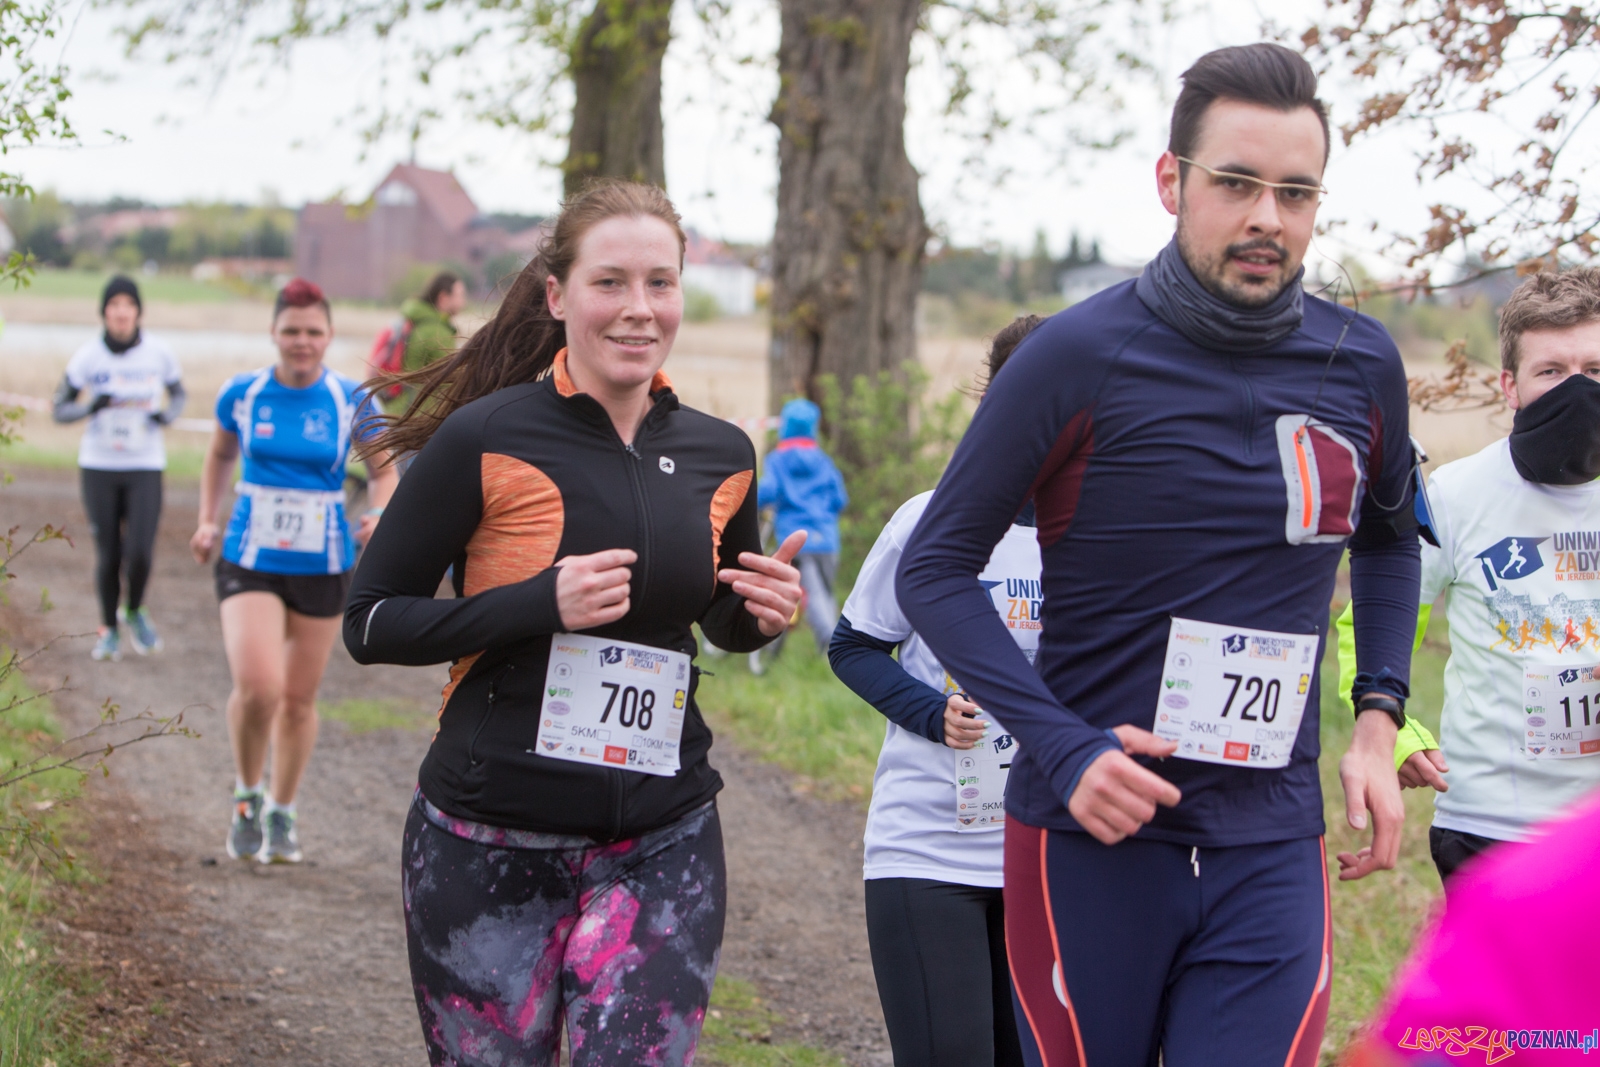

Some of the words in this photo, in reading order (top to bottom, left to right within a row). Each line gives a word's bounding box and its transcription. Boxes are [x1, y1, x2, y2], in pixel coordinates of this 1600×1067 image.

[1553, 531, 1600, 551] UNIW
[1567, 572, 1595, 581] JERZEGO
[1007, 599, 1042, 621] ZAD
[1220, 672, 1281, 723] 720
[599, 681, 656, 731] 708
[571, 725, 597, 739] 5KM
[1189, 720, 1217, 734] 5KM
[642, 737, 664, 749] 10KM
[1550, 732, 1571, 741] 5KM
[981, 801, 1002, 811] 5KM
